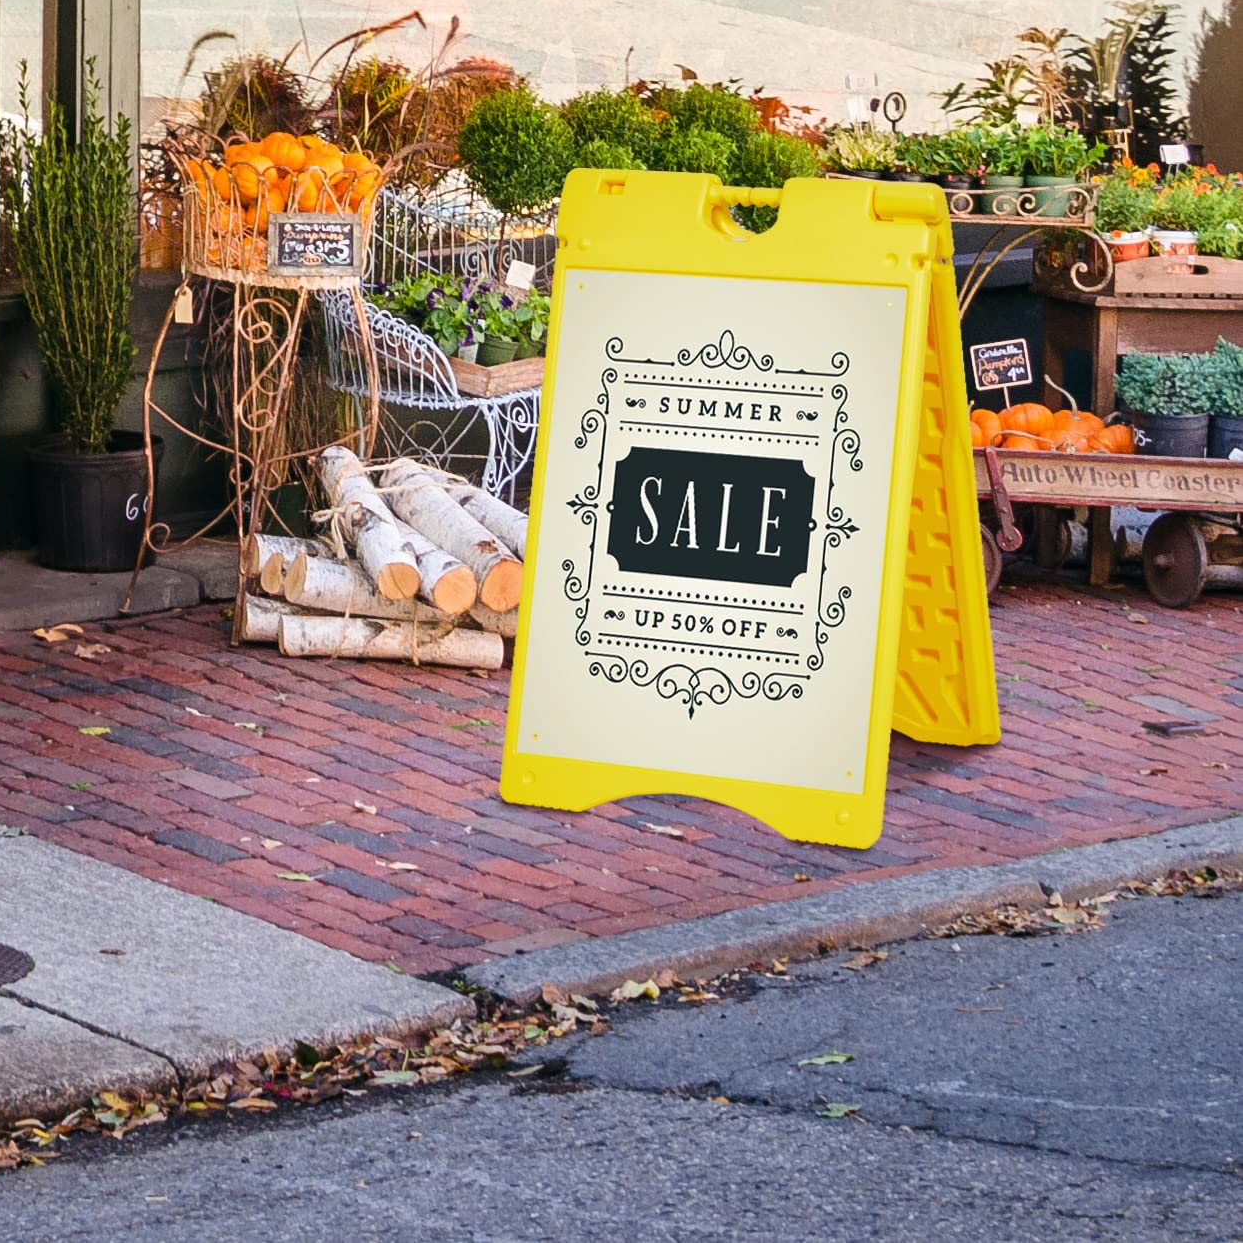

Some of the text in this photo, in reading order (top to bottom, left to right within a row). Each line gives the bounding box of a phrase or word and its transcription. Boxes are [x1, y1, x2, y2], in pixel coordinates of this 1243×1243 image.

[658, 396, 784, 423] SUMMER
[1145, 469, 1241, 494] Coaster
[635, 475, 787, 558] SALE
[634, 609, 768, 640] UP 50% OFF
